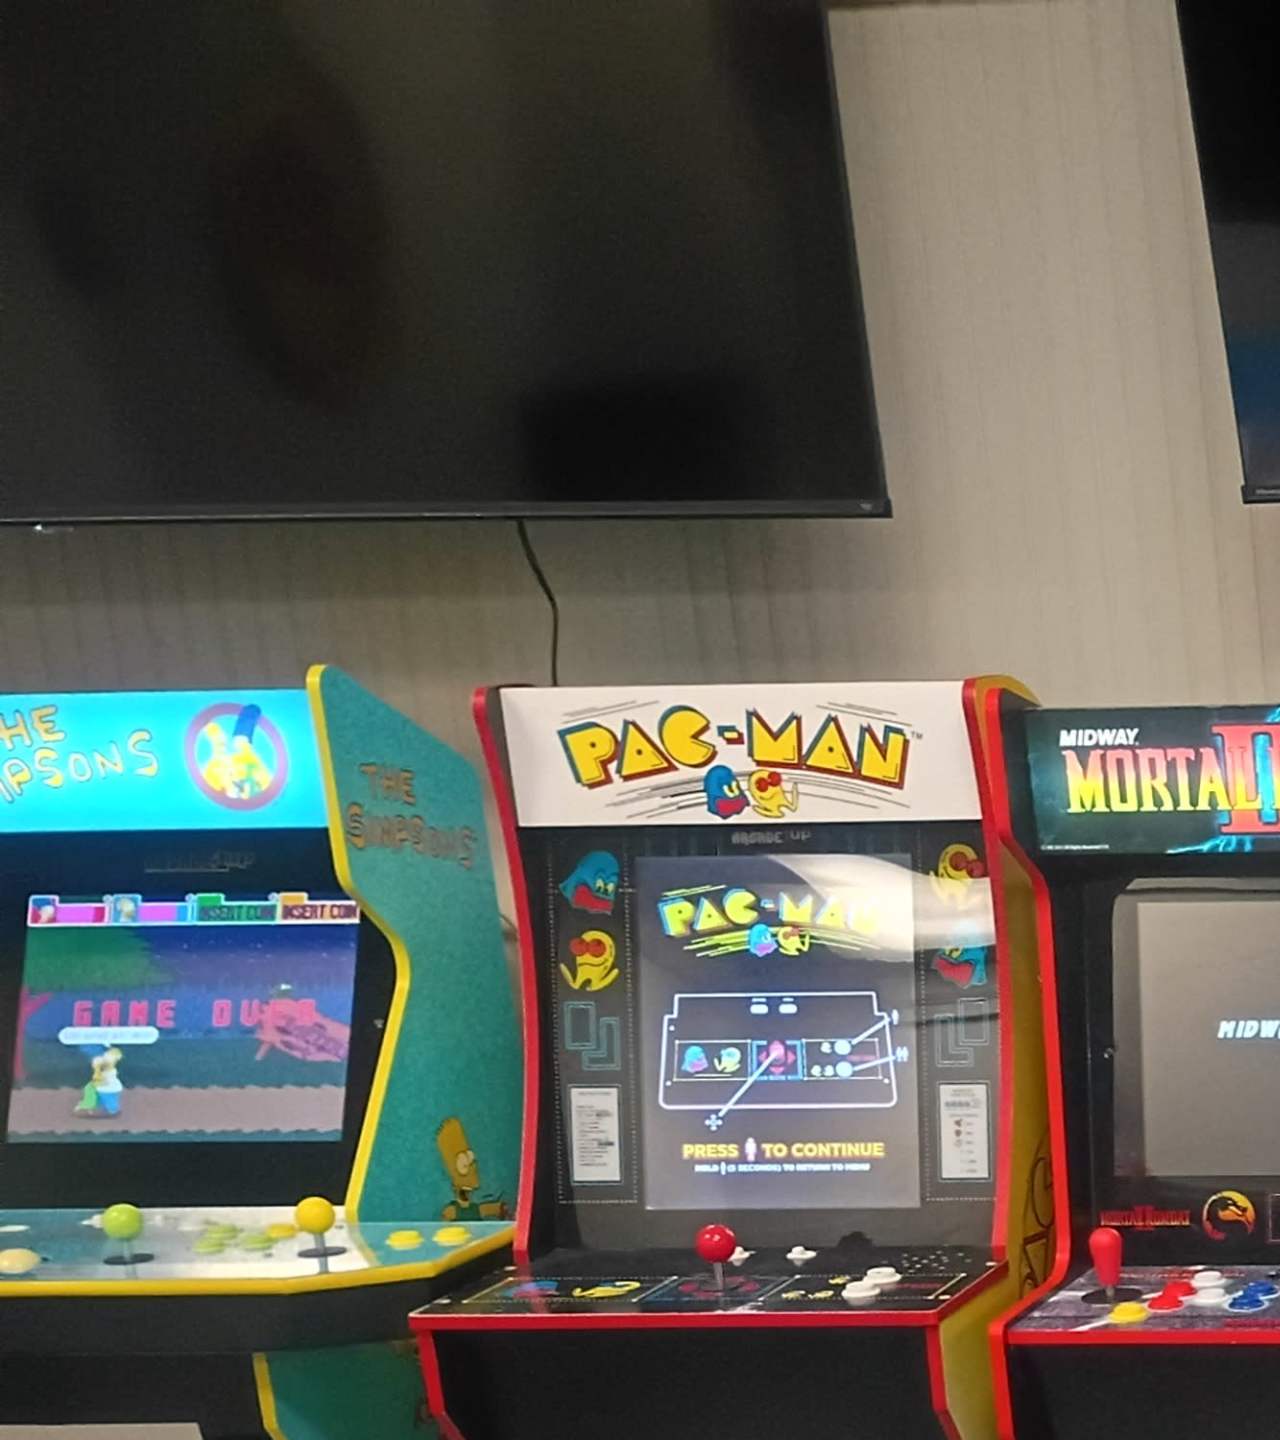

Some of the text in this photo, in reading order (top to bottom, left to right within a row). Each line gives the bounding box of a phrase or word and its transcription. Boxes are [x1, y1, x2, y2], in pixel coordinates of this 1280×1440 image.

[0, 704, 66, 751] HE
[558, 704, 907, 790] PAC-MAN
[1060, 728, 1139, 746] MIDWAY
[0, 729, 158, 804] PSONS
[1062, 741, 1260, 813] MORTAL
[73, 1000, 176, 1028] GAME
[682, 1142, 885, 1159] PRESS TO CONTINUE
